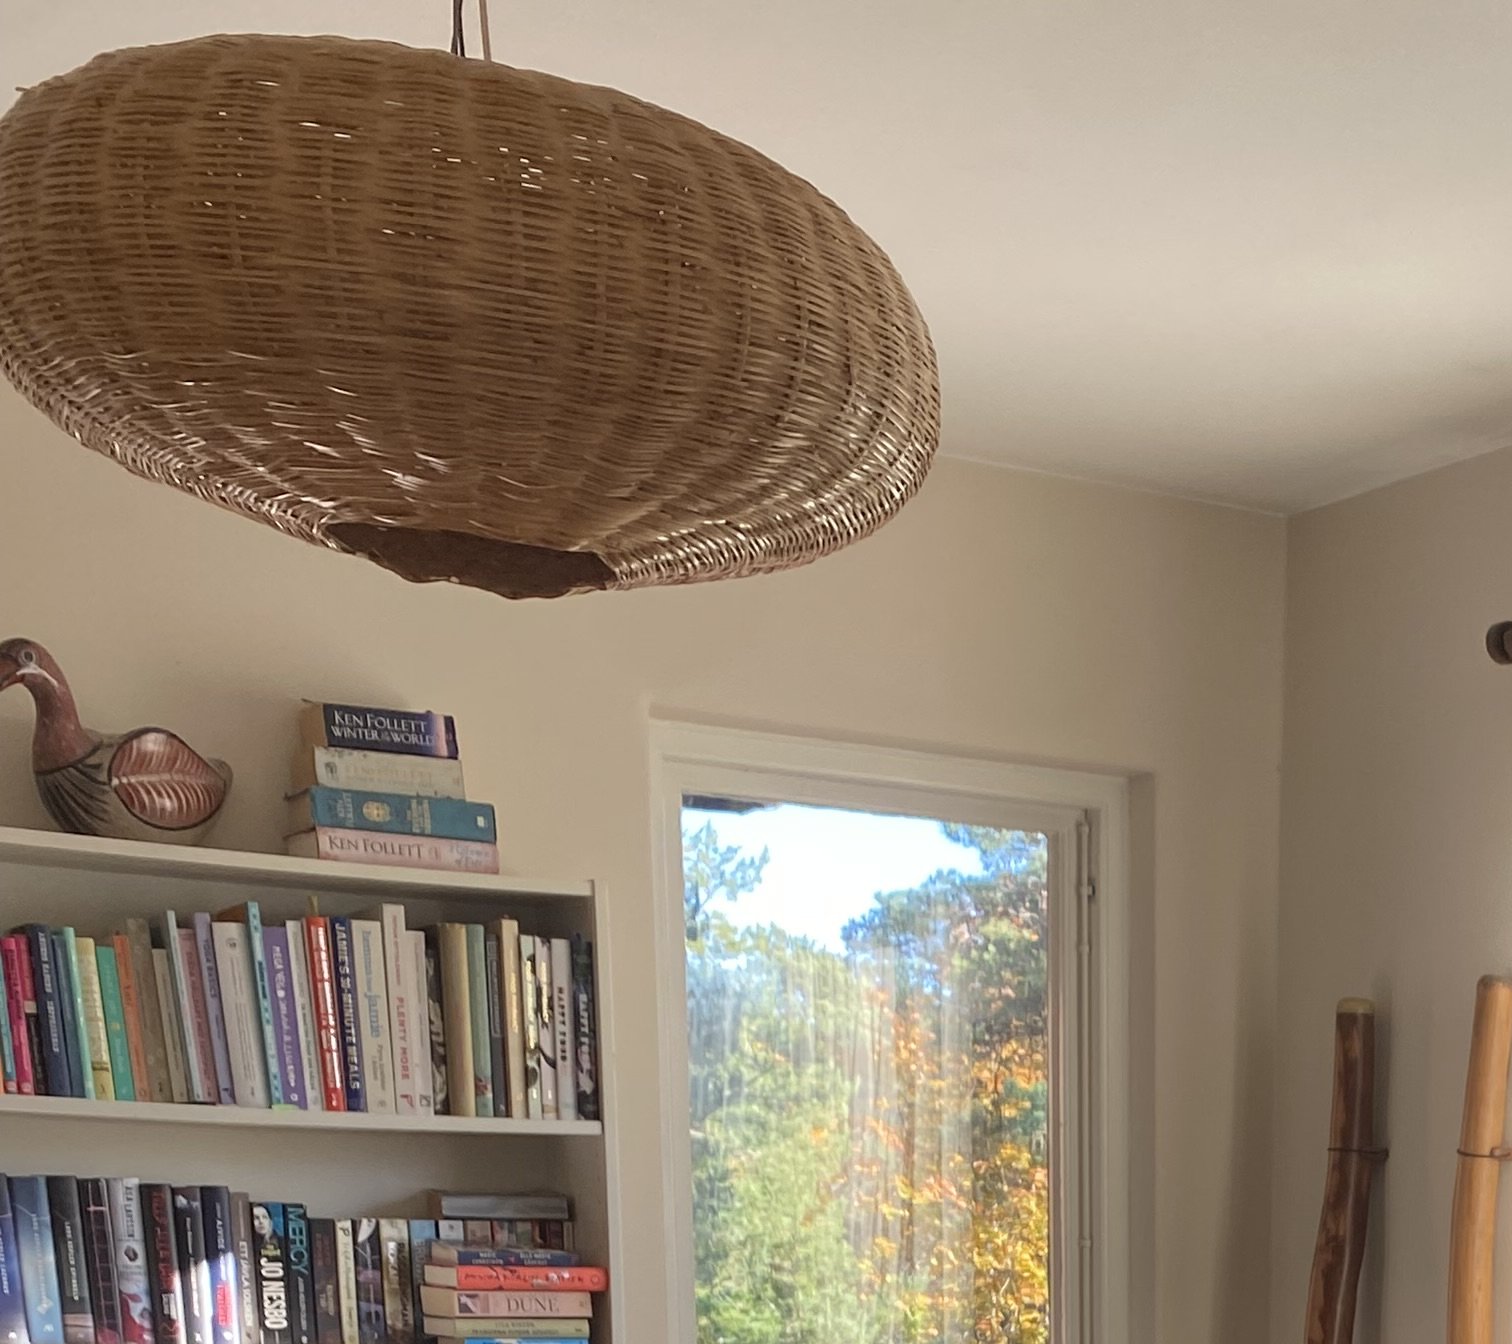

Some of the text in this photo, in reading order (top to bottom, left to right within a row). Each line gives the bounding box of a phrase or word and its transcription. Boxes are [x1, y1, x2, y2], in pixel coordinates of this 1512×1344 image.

[334, 711, 427, 733] KEN FOLLETT
[331, 724, 379, 741] WINTER
[390, 732, 433, 746] WORLD
[328, 835, 424, 859] KEN FOLLETT
[335, 922, 350, 974] JAMIE'S
[347, 1045, 360, 1090] MEALS
[396, 996, 411, 1080] PLENTY MORE
[287, 1206, 309, 1276] MERCY
[260, 1257, 284, 1278] JO
[506, 1297, 559, 1313] DUNE
